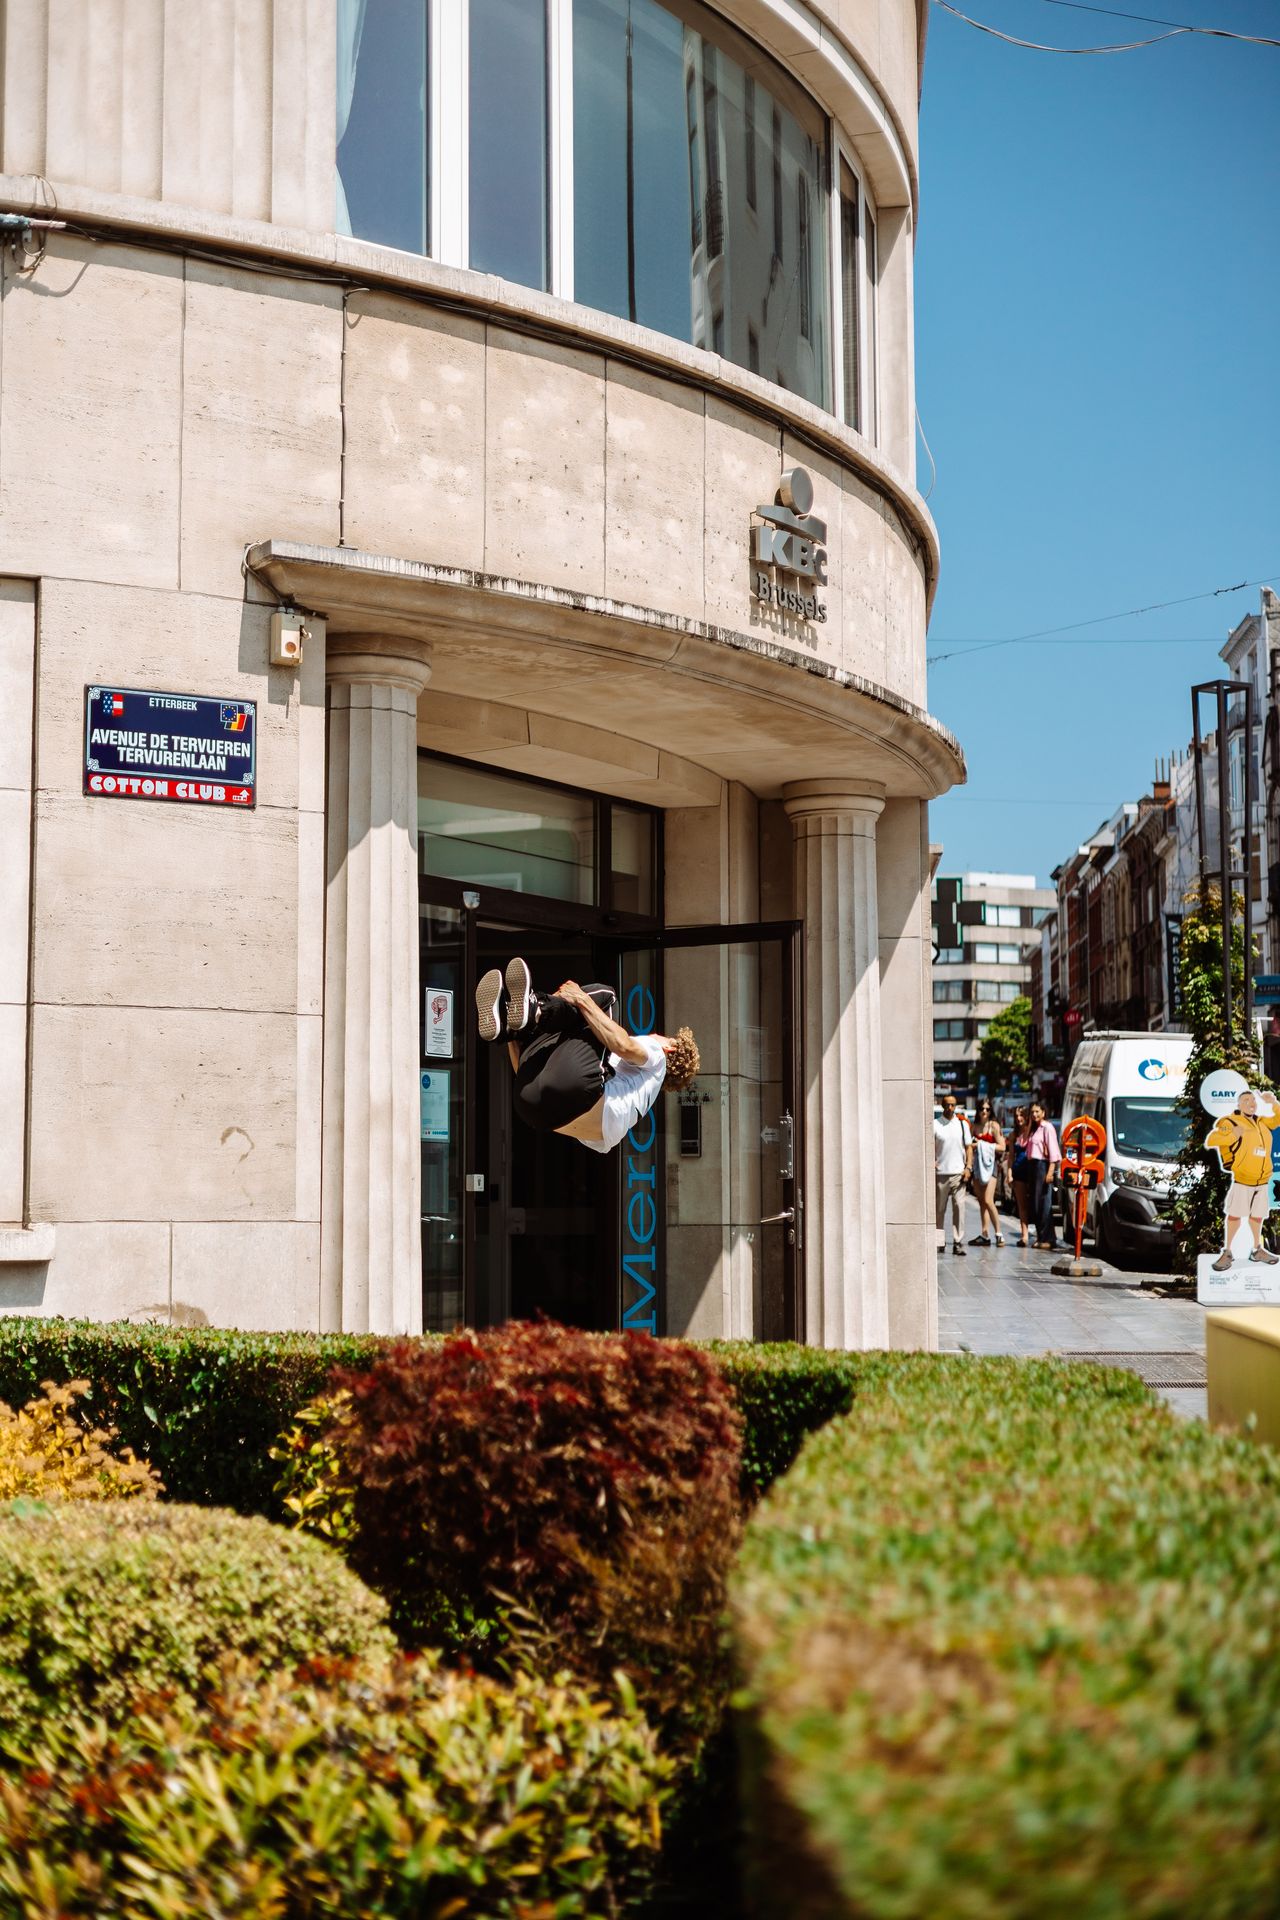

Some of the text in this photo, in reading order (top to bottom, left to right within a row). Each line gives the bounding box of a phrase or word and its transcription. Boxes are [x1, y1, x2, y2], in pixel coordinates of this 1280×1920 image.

[755, 525, 828, 587] KBC
[757, 571, 828, 624] Brussels
[149, 697, 198, 711] ETTERBEEK
[91, 728, 251, 758] AVENUE DE TERVUEREN
[117, 747, 226, 771] TERVURENLAAN
[90, 775, 226, 801] COTTON CLUB
[1211, 1090, 1237, 1098] GARY
[622, 983, 657, 1336] Meroe
